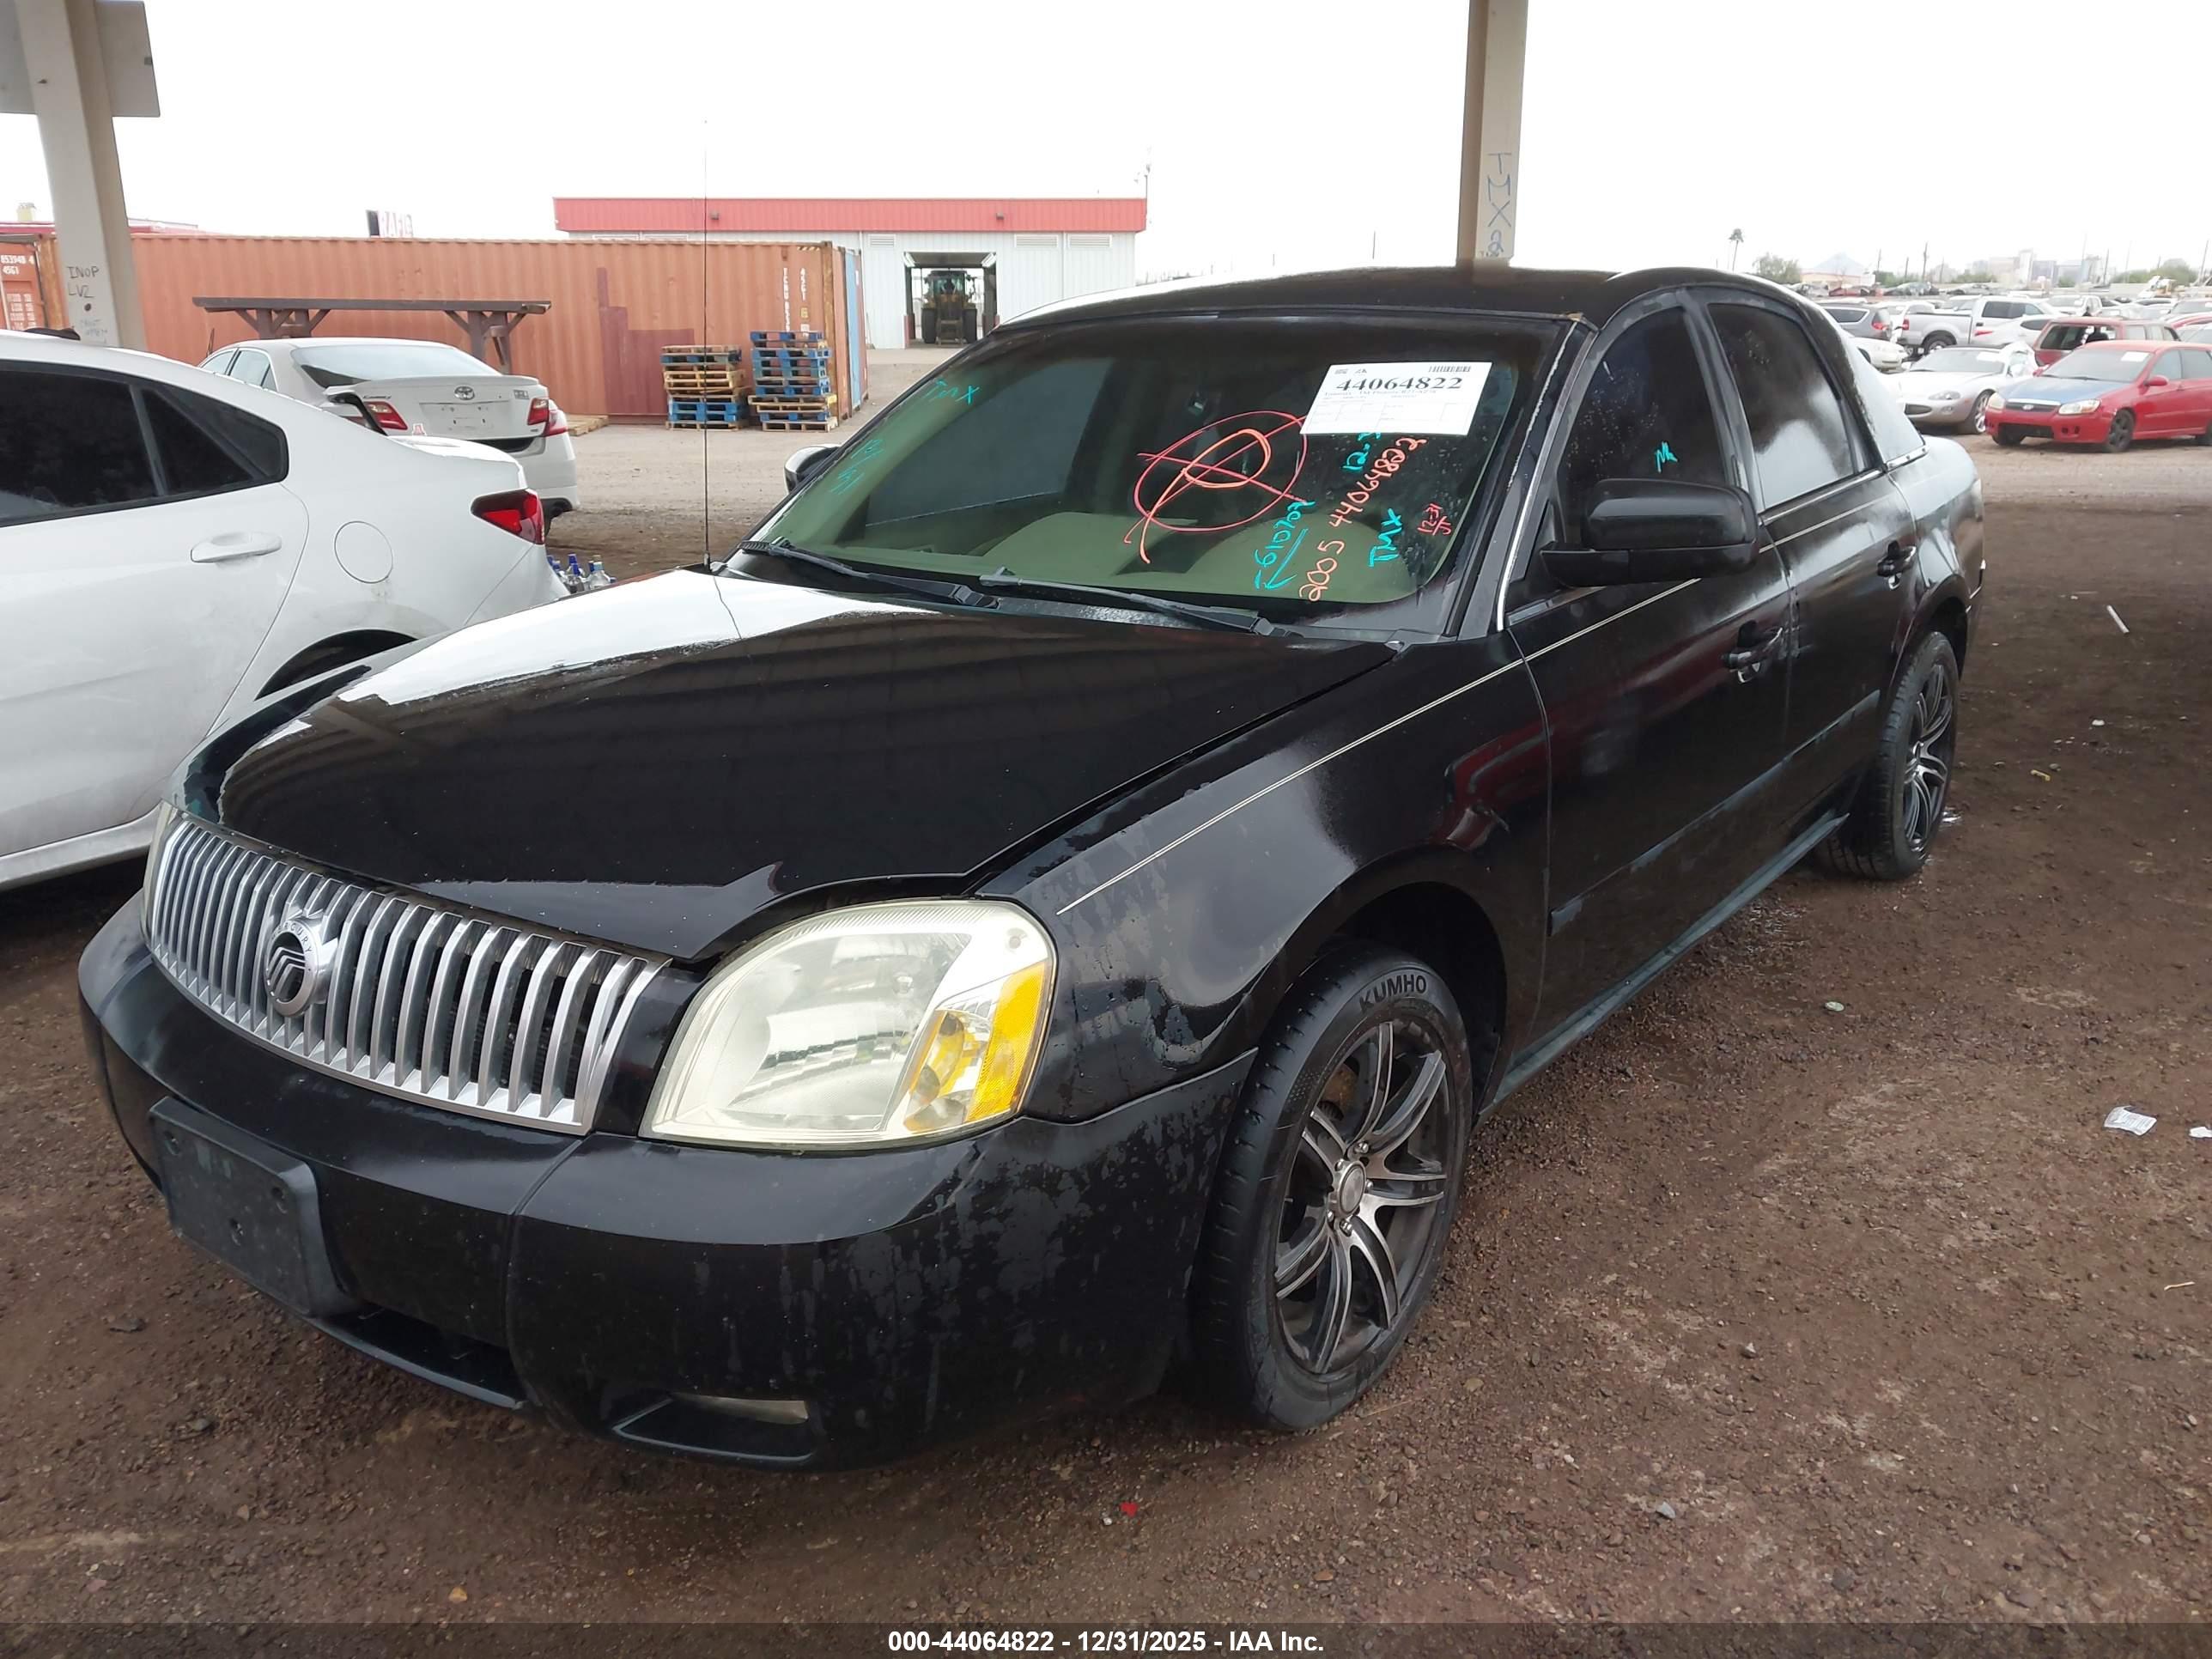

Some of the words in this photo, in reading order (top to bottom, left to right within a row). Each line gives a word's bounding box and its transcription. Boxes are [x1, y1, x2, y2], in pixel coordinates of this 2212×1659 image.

[66, 266, 100, 279] INOP
[1335, 376, 1463, 391] 44064822
[1299, 540, 1346, 602] 2005
[1358, 973, 1428, 1012] KUMHO
